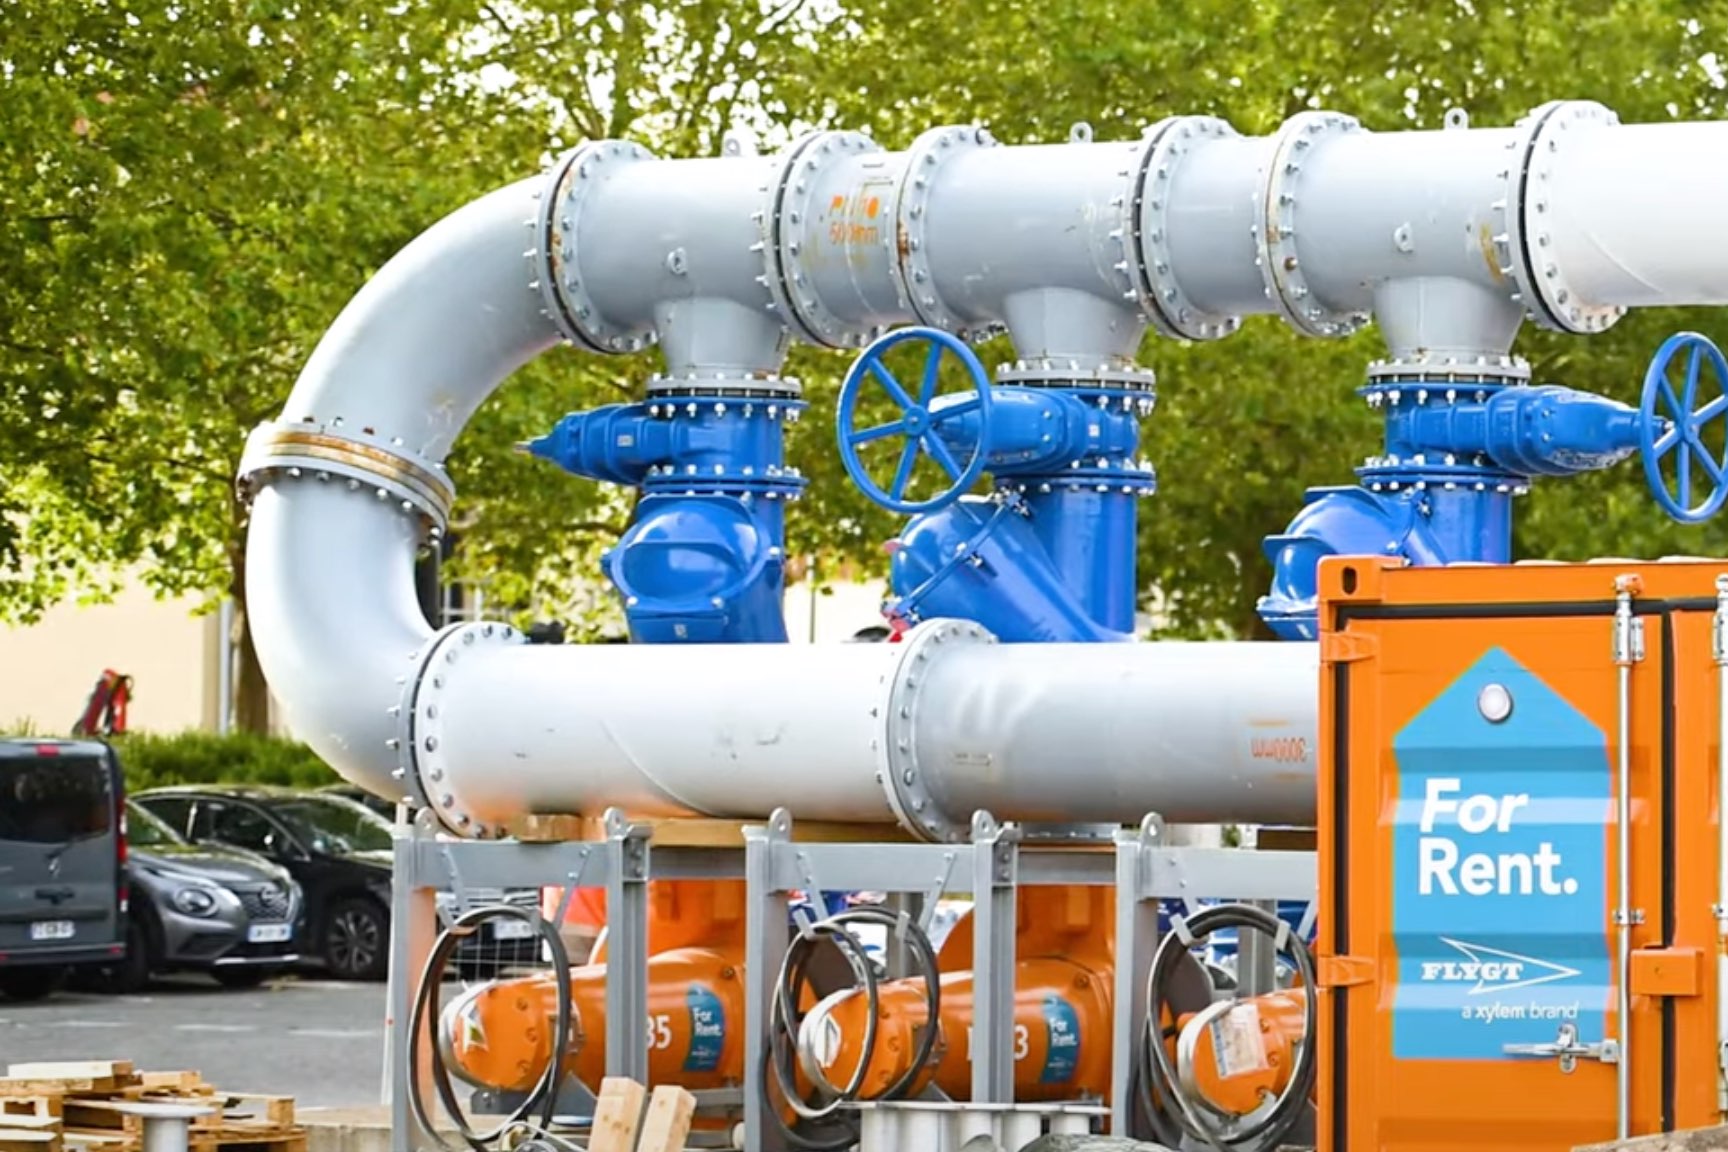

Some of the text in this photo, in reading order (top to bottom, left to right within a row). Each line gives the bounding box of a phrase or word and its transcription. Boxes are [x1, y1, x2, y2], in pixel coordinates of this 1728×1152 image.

[1419, 777, 1529, 834] For
[1418, 836, 1579, 896] Rent.
[1421, 962, 1525, 981] FLYGT
[1461, 1000, 1580, 1024] a xylem brand
